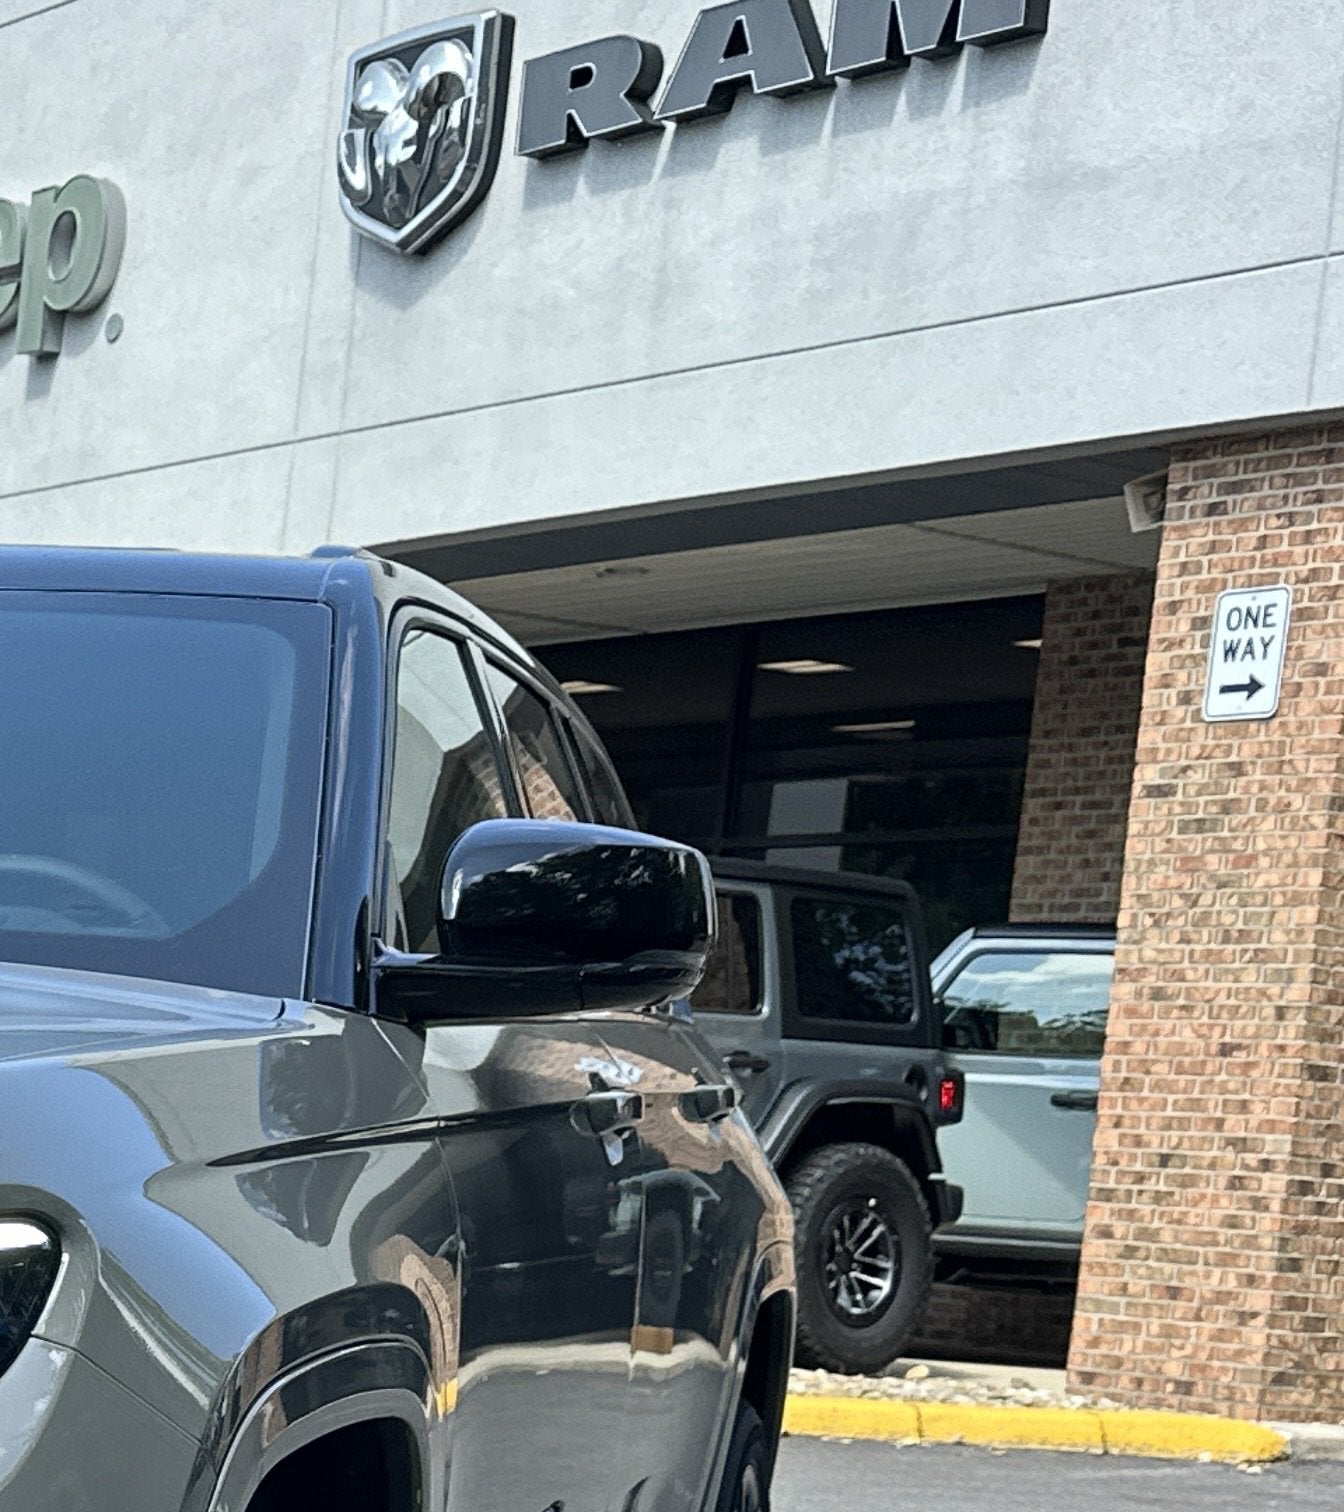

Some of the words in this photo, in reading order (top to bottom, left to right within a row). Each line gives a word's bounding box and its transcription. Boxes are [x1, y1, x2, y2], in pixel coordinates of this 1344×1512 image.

[514, 0, 1049, 158] RAM
[1226, 603, 1278, 631] ONE
[1223, 635, 1275, 663] WAY
